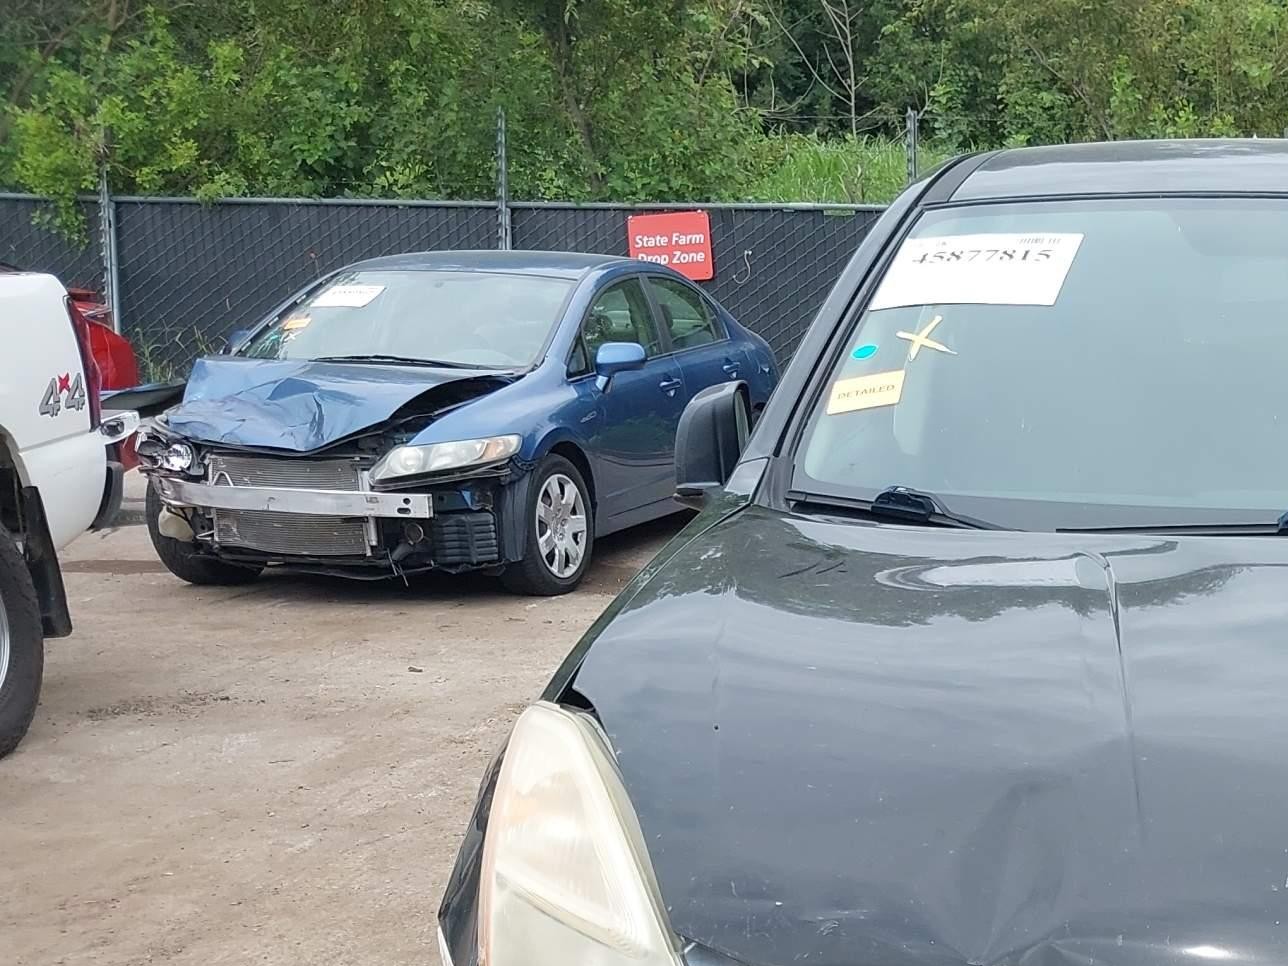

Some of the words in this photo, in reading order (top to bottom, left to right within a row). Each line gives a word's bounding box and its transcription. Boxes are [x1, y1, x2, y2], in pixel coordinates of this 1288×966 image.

[635, 235, 668, 248] State
[672, 232, 704, 245] Farm
[672, 250, 705, 264] Zone
[912, 249, 1053, 264] 45877815
[837, 384, 895, 399] DETAILED
